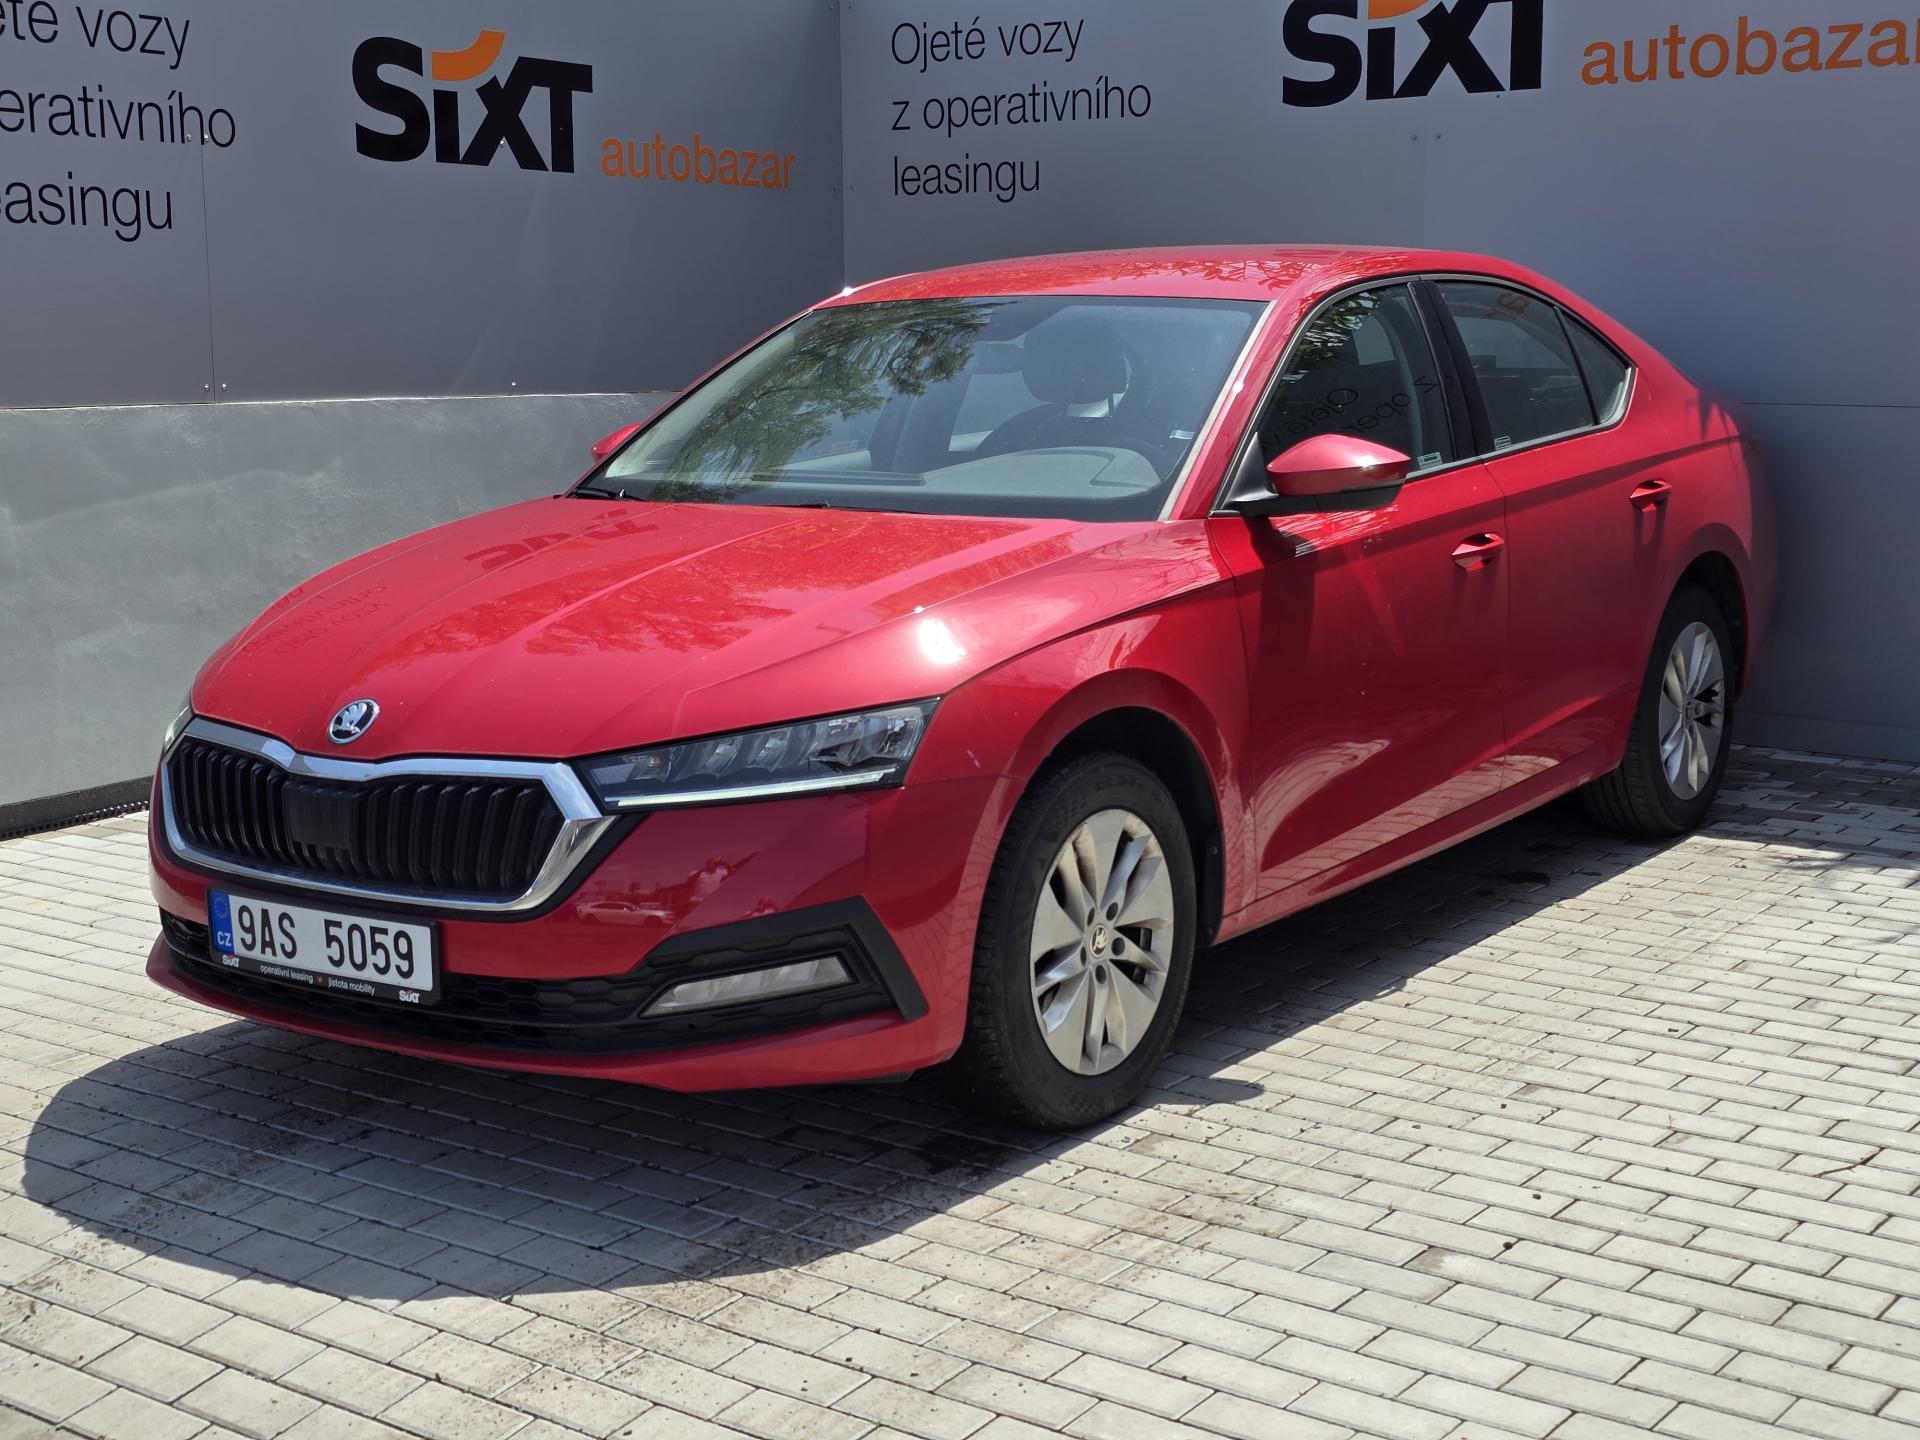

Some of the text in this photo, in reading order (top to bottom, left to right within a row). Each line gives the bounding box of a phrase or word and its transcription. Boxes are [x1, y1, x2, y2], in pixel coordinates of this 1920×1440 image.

[75, 6, 190, 70] vozy
[891, 16, 1084, 73] Ojeté vozy
[1581, 16, 1920, 85] autobaza
[0, 84, 236, 148] erativního
[892, 75, 1151, 138] z operativního
[600, 132, 796, 190] autobazar
[894, 153, 1040, 203] leasingu
[0, 171, 173, 243] asingu
[217, 931, 232, 947] CZ
[238, 905, 414, 979] 9AS 5059
[290, 970, 314, 985] leasing
[328, 977, 349, 989] jistota
[349, 982, 376, 996] mobility
